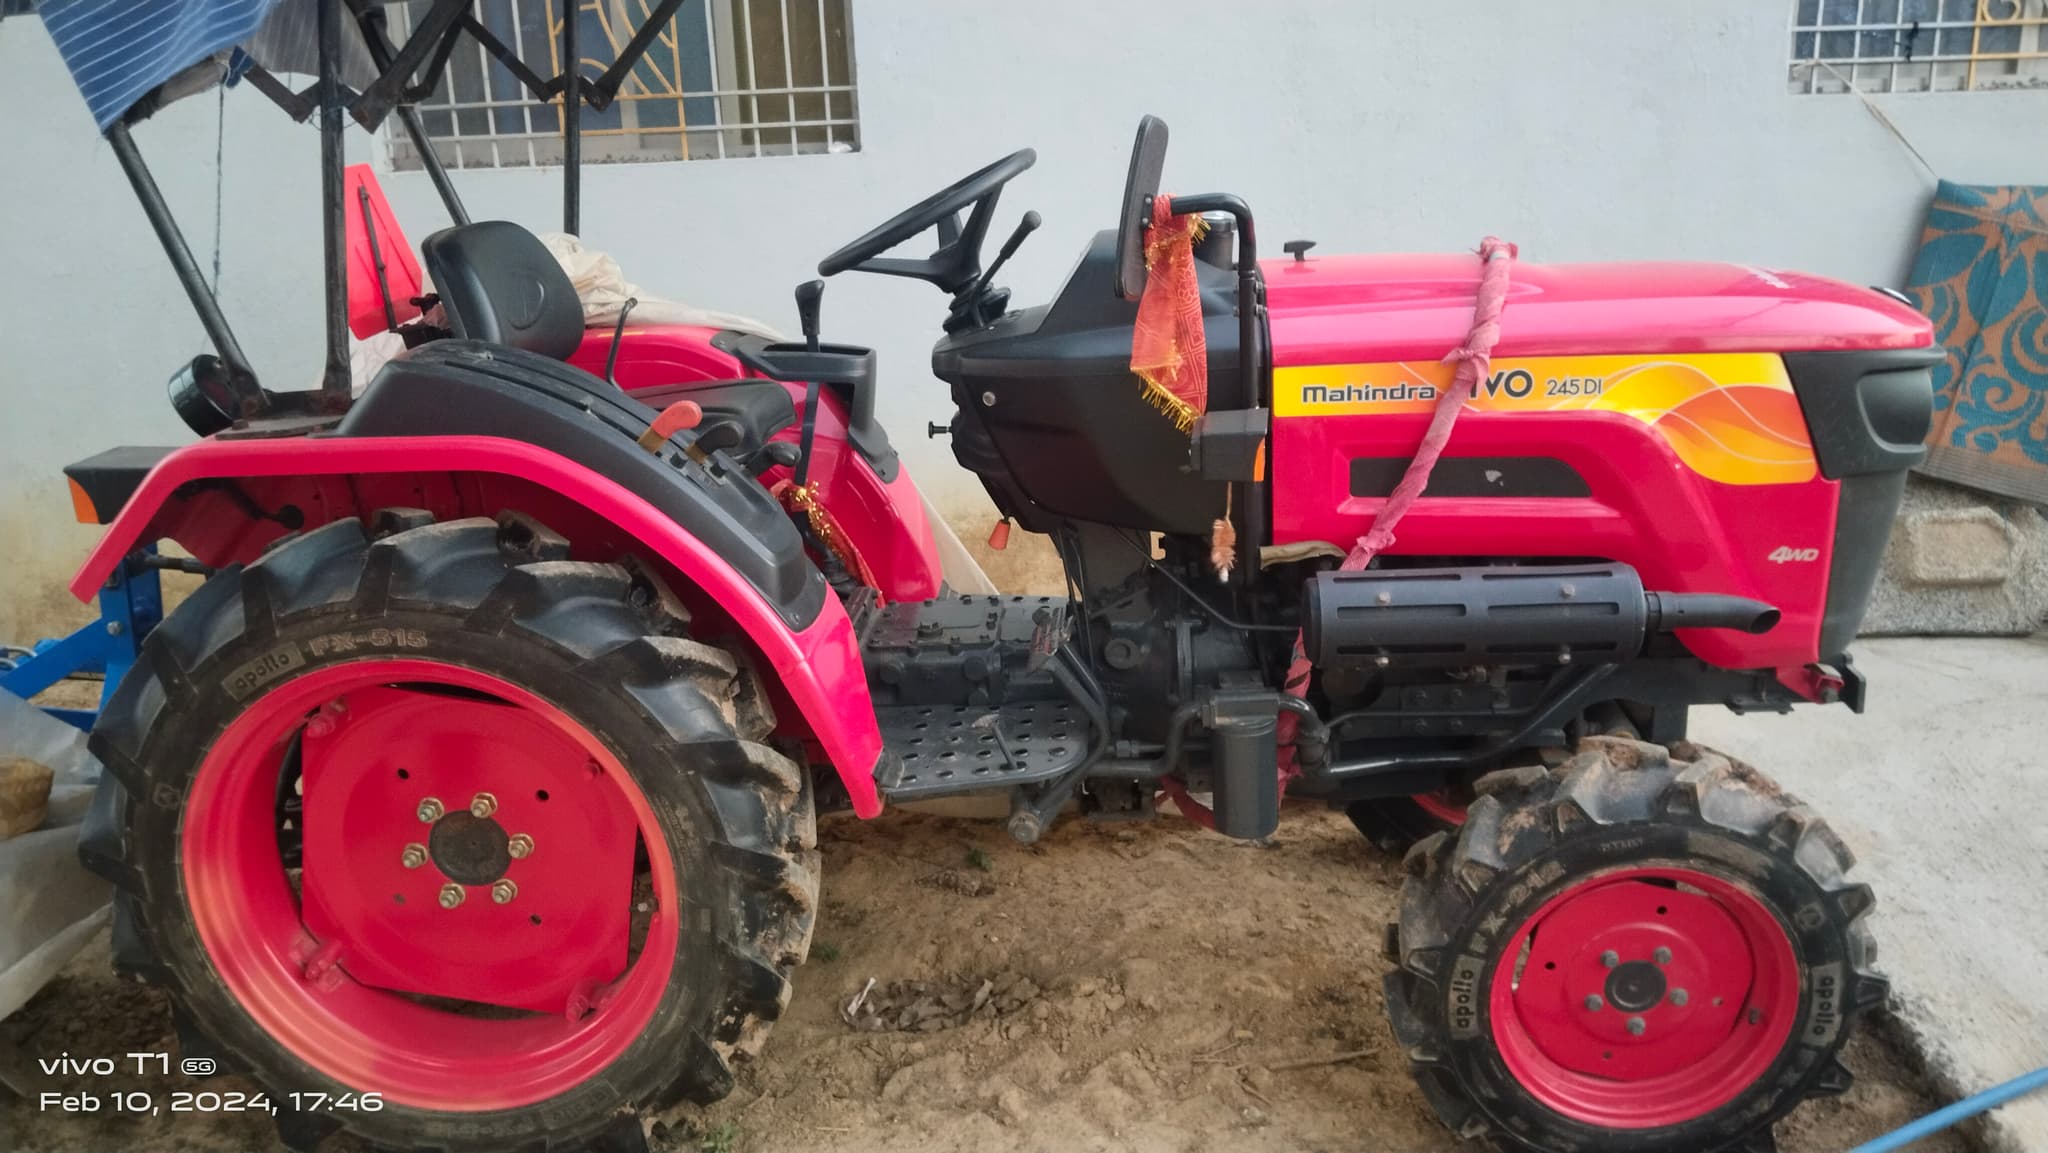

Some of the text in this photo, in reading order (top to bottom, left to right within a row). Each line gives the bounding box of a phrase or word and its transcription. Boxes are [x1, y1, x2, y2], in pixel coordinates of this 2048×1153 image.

[1302, 383, 1436, 402] Mahindra
[1546, 378, 1580, 396] 245
[1583, 378, 1602, 395] DI
[1767, 544, 1819, 564] 4WD
[233, 651, 291, 690] apollo
[1452, 969, 1475, 1029] apollo
[1812, 975, 1836, 1036] apollo
